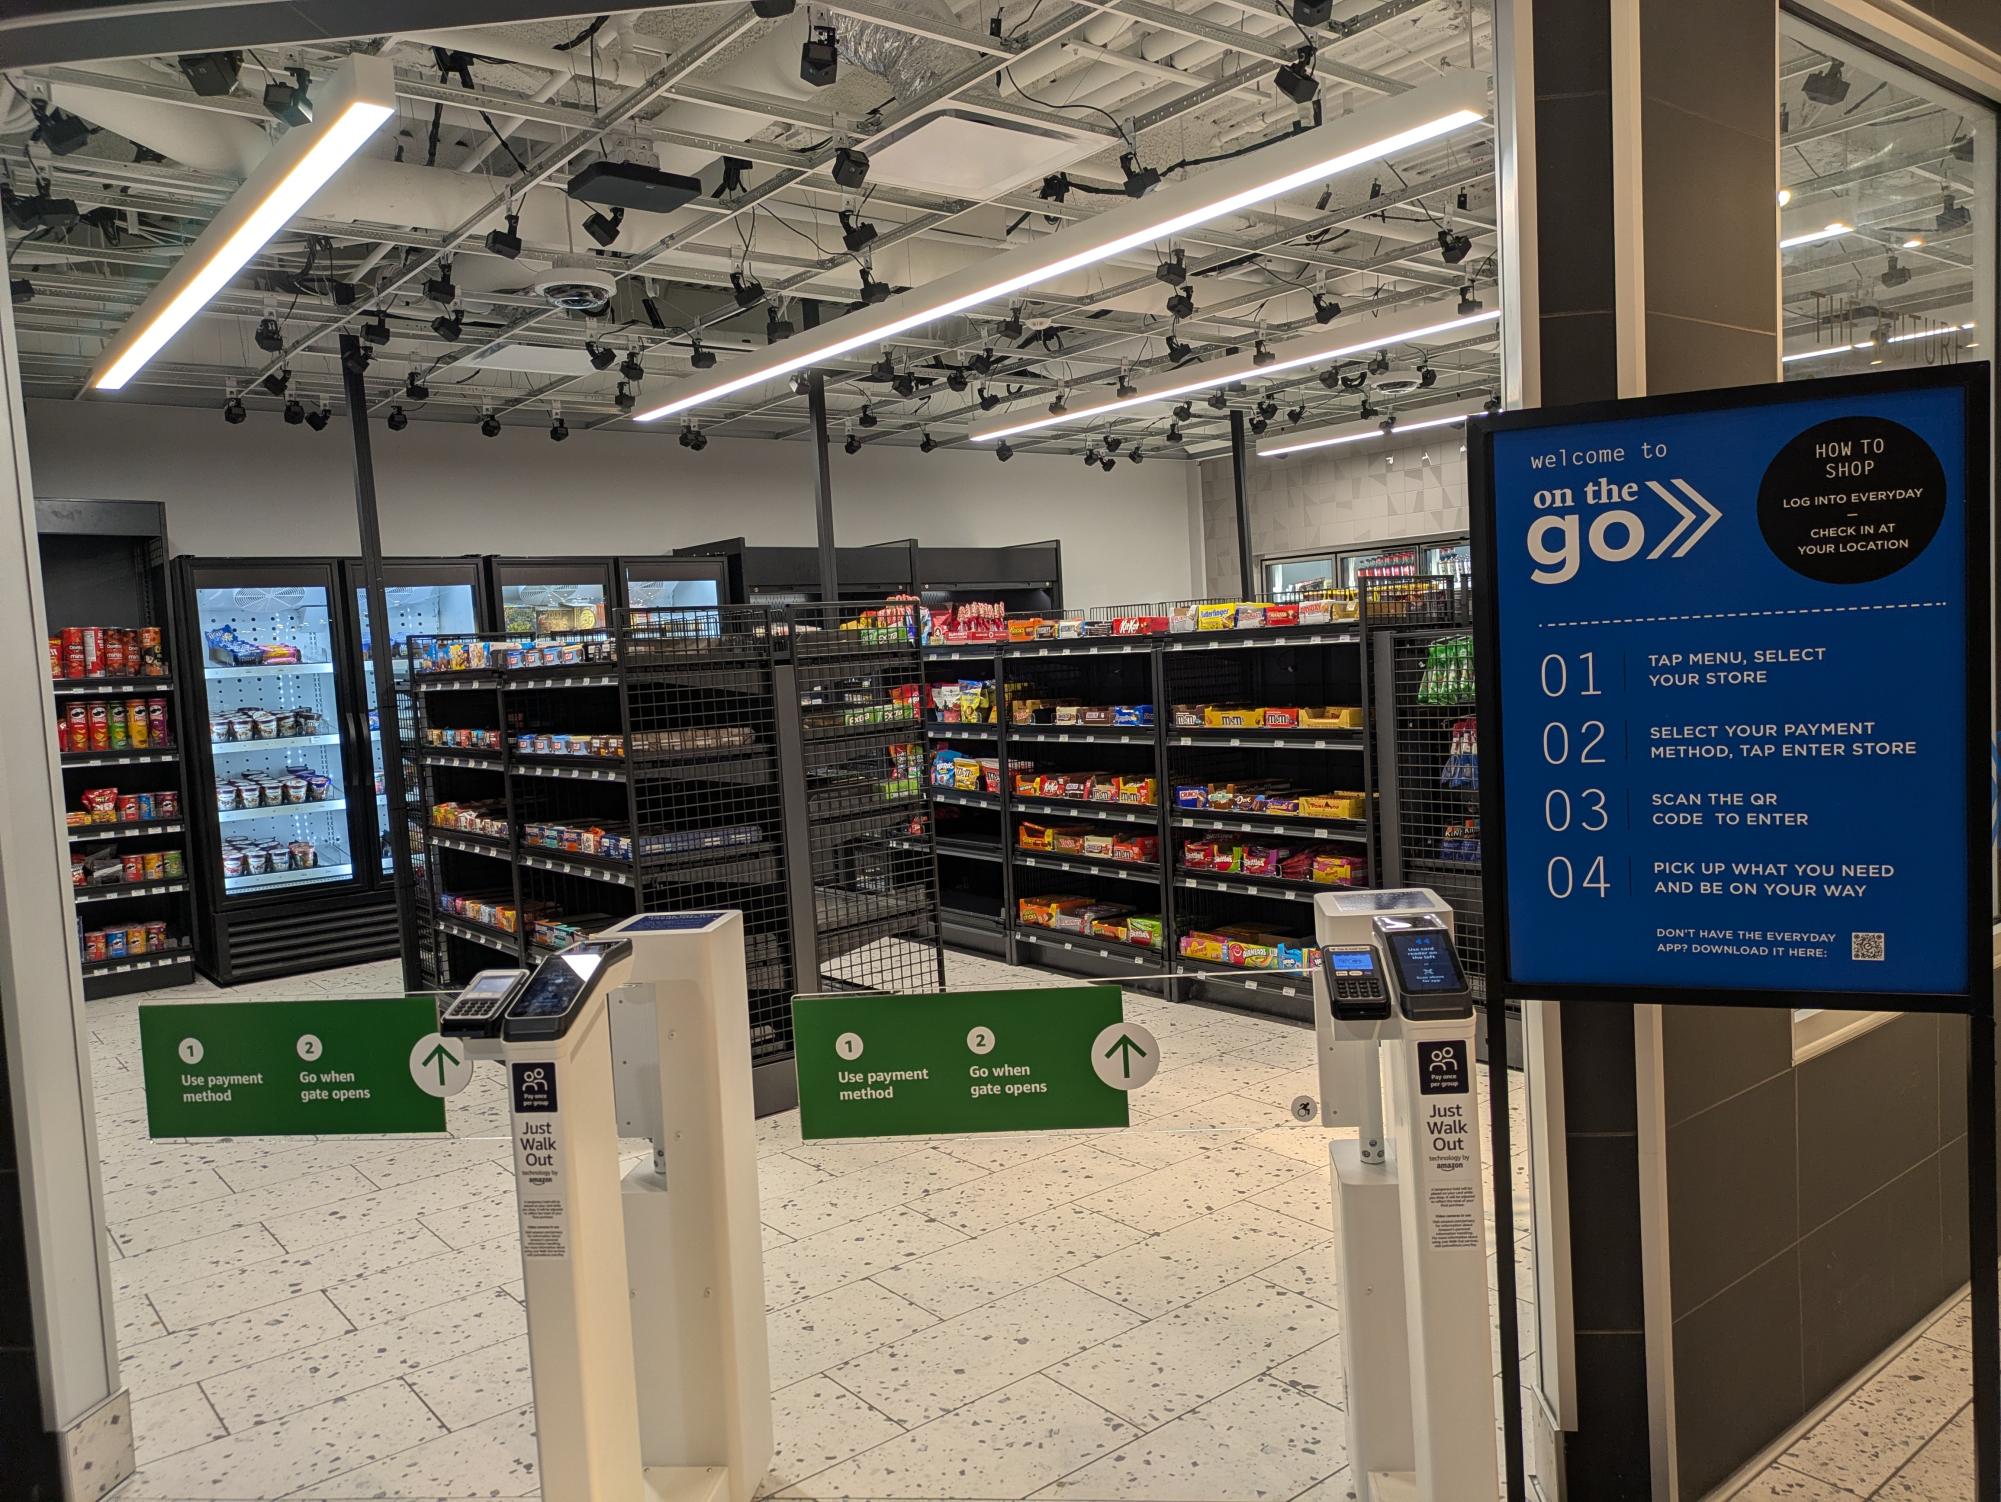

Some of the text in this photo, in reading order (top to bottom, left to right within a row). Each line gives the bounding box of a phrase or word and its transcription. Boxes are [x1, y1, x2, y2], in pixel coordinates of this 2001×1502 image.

[1816, 439, 1883, 458] HOW TO
[1531, 443, 1666, 468] welcome to
[1826, 461, 1874, 478] SHOP
[1534, 478, 1638, 508] on the
[1784, 489, 1923, 507] LOG INTO EVERYDAY
[1811, 524, 1896, 538] CHECK IN AT
[1527, 509, 1644, 584] go
[1798, 539, 1908, 554] YOUR LOCATION
[1649, 648, 1825, 666] TAP MENU, SELECT
[1542, 652, 1601, 696] 01
[1649, 671, 1766, 686] YOUR STORE
[1651, 722, 1875, 738] SELECT YOUR PAYMENT
[1544, 721, 1605, 764] 02
[1652, 742, 1916, 758] METHOD, TAP ENTER STORE
[1653, 794, 1776, 805] SCAN THE QR
[1546, 789, 1607, 831] 03
[1653, 813, 1808, 825] CODE TO ENTER
[1655, 863, 1894, 876] PICK UP WHAT YOU NEED
[1548, 856, 1610, 898] 04
[1655, 882, 1866, 896] AND BE ON YOUR WAY
[1657, 929, 1835, 942] DON'T HAVE THE EVERYDAY
[1658, 944, 1687, 952] APP?
[1692, 945, 1768, 955] DOWNLOAD
[1790, 948, 1826, 957] HERE:
[845, 1040, 852, 1052] 1
[976, 1034, 985, 1047] 2
[187, 1045, 193, 1057] 1
[305, 1042, 314, 1054] 2
[300, 1071, 354, 1083] Go when
[839, 1069, 928, 1084] Use payment
[970, 1064, 1030, 1077] Go when
[182, 1074, 263, 1087] Use payment
[184, 1090, 231, 1102] method
[301, 1089, 370, 1102] gate opens
[840, 1086, 893, 1100] method
[971, 1084, 1047, 1097] gate opens
[1430, 1104, 1462, 1118] Just
[523, 1122, 551, 1134] Just
[1427, 1120, 1467, 1134] Walk
[520, 1137, 556, 1150] Walk
[1433, 1138, 1464, 1151] Out
[526, 1153, 553, 1166] Out
[1428, 1154, 1470, 1162] technology by
[1436, 1162, 1464, 1170] amazon
